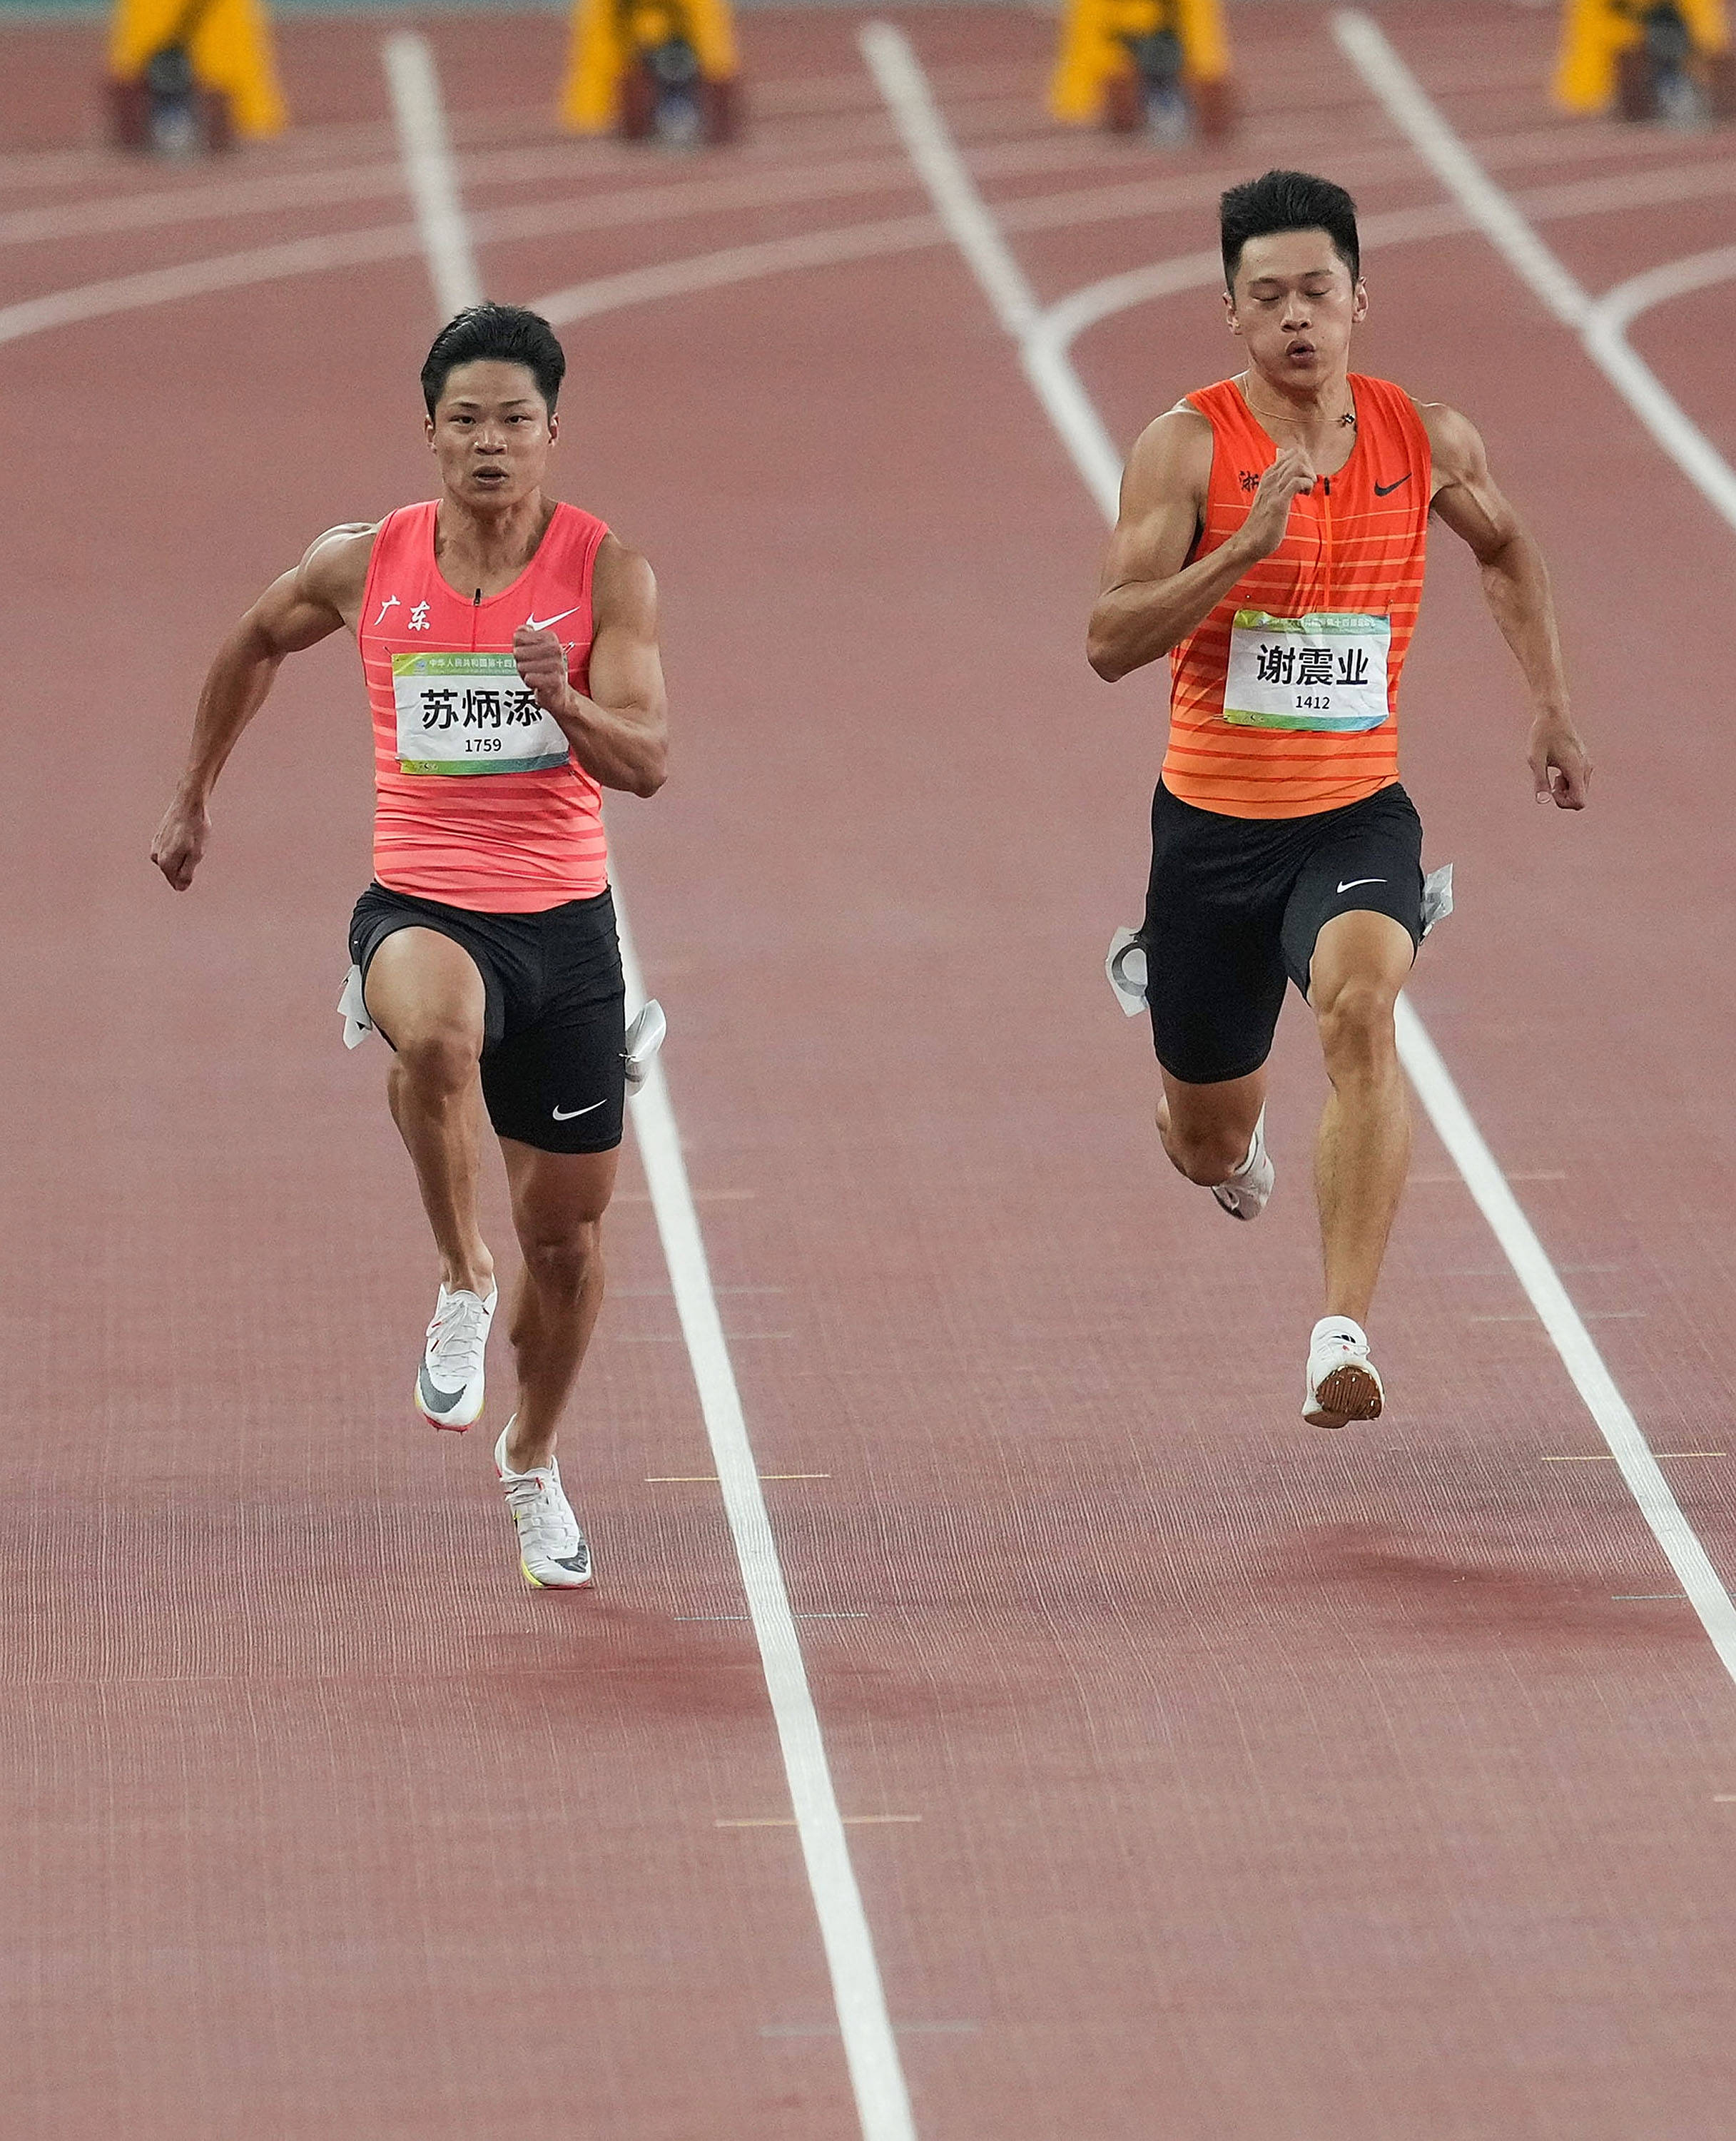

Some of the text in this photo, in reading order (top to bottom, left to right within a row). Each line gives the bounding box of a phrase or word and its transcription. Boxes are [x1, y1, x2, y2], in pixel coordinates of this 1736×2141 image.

[374, 594, 430, 632] 广东
[1257, 644, 1369, 685] 谢震业
[420, 689, 543, 729] 苏炳添
[1296, 696, 1330, 709] 1412
[465, 739, 502, 752] 1759
